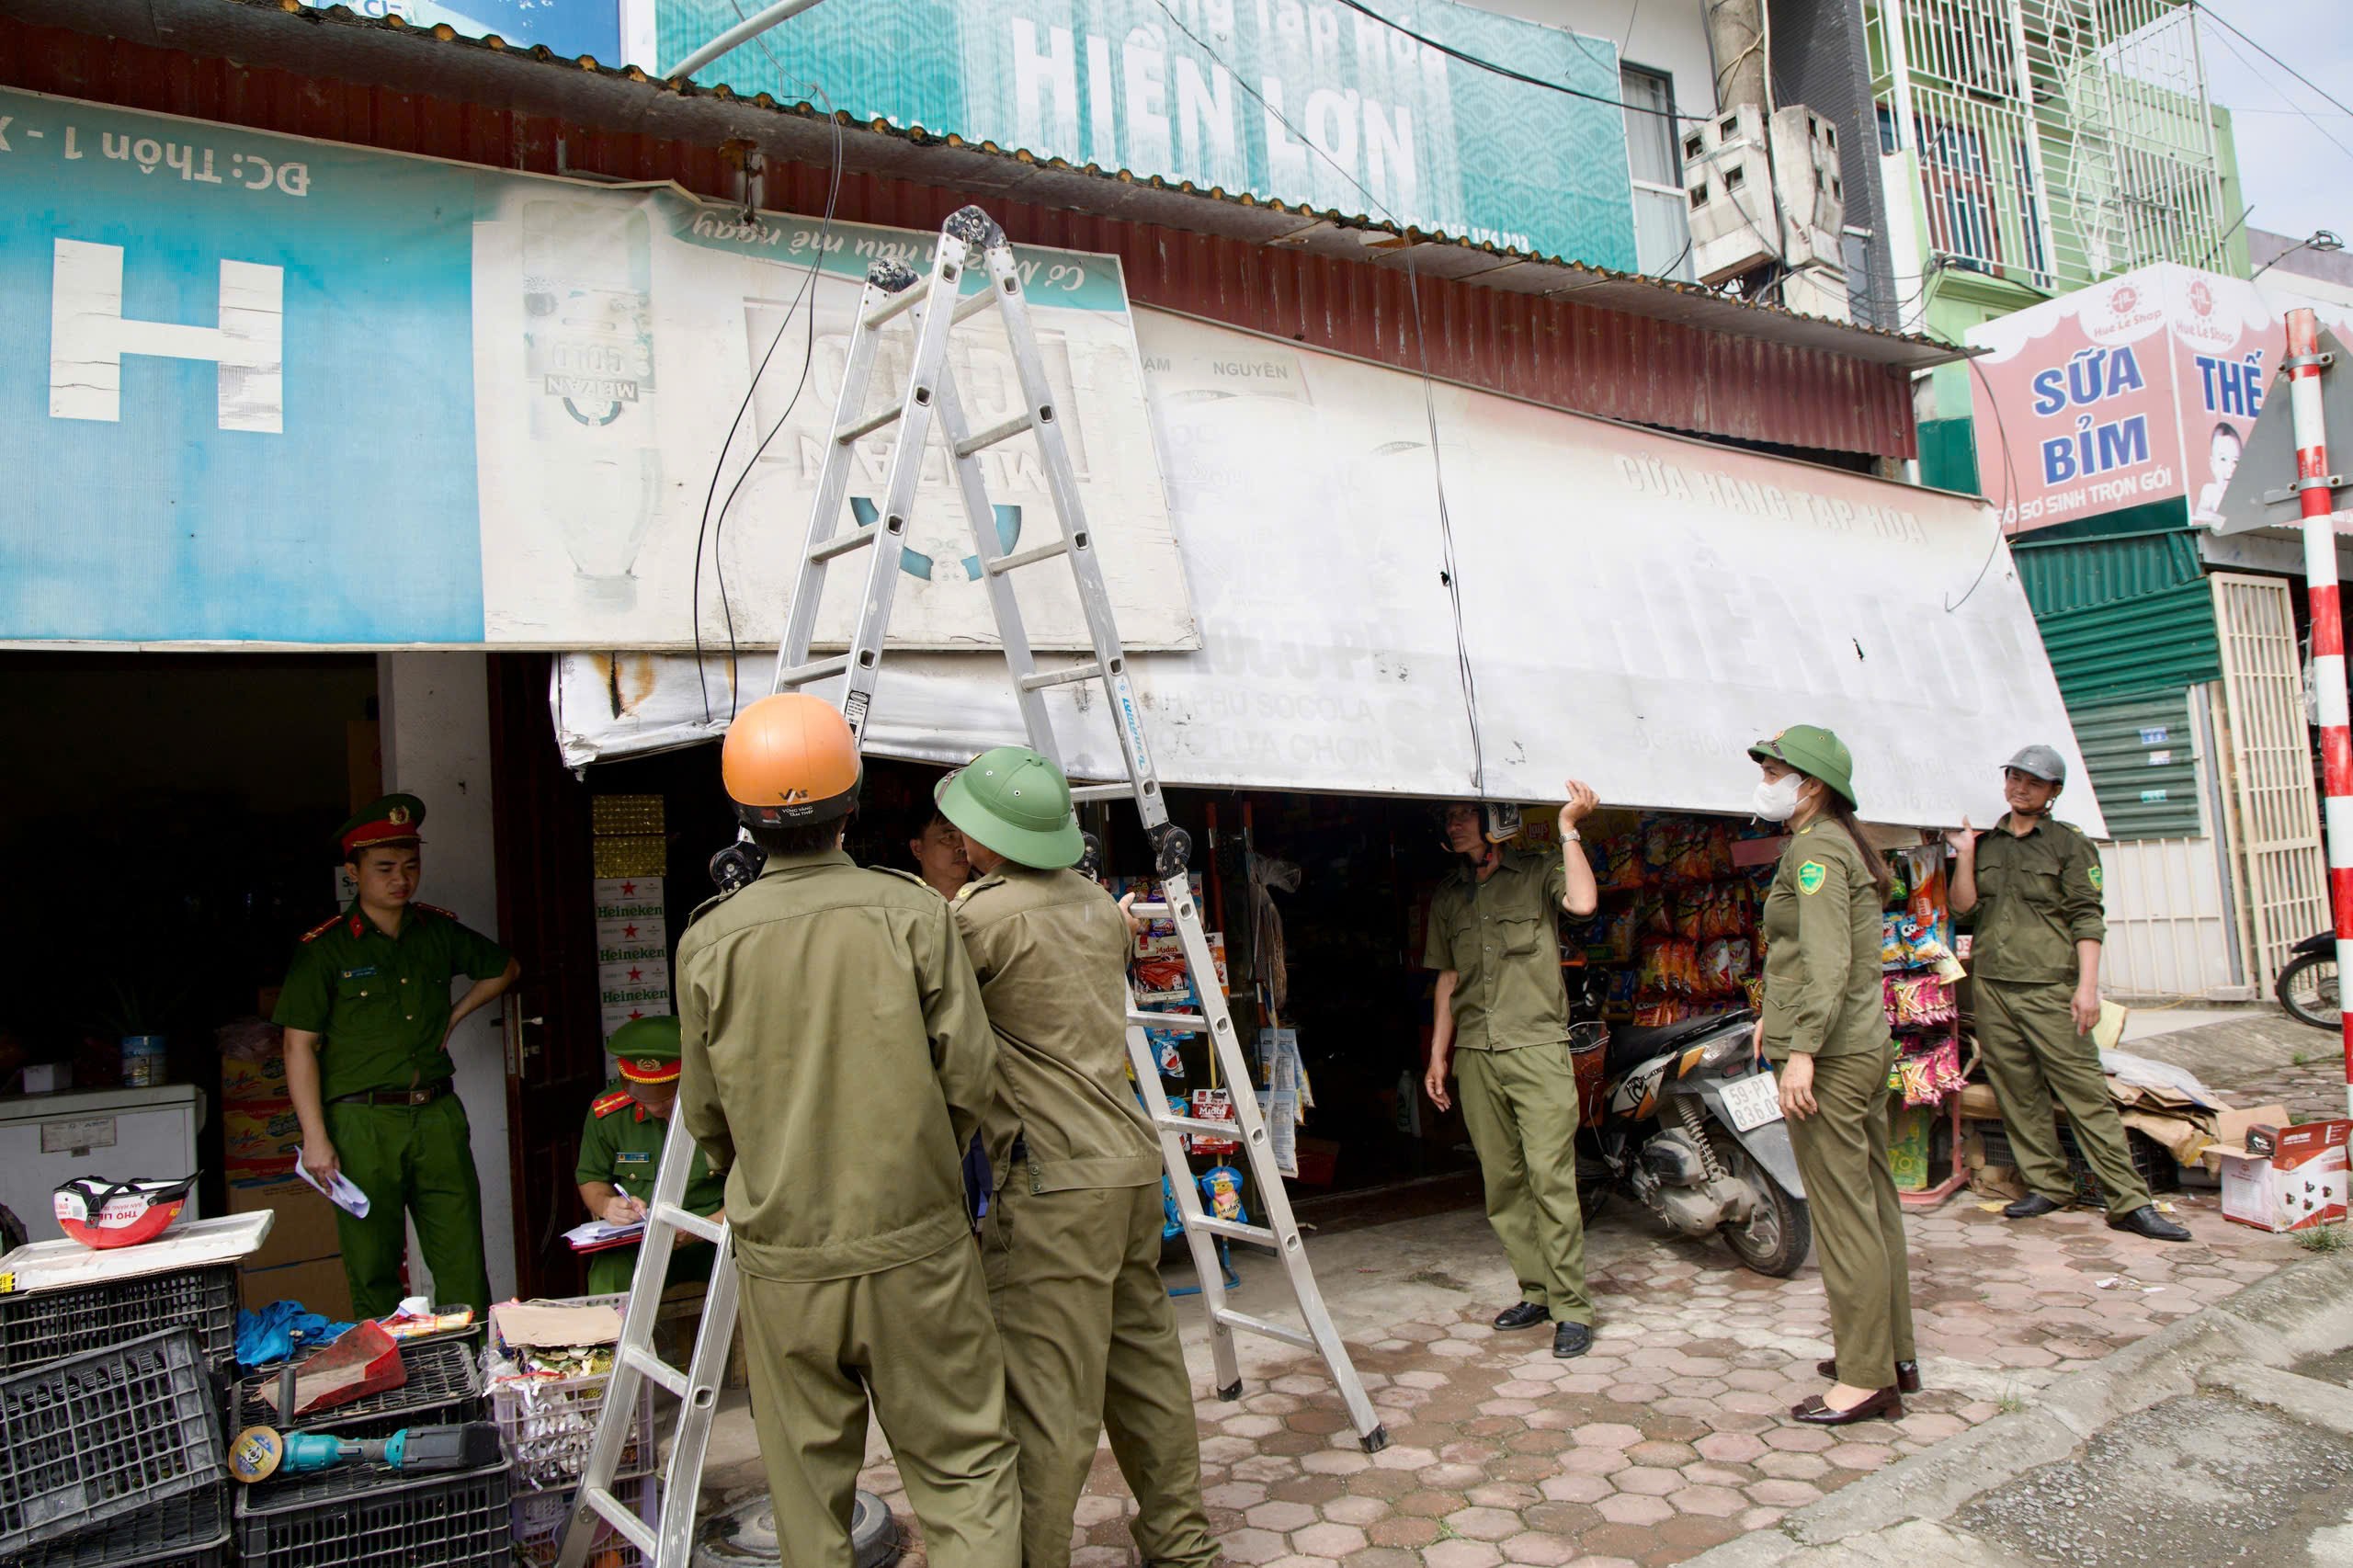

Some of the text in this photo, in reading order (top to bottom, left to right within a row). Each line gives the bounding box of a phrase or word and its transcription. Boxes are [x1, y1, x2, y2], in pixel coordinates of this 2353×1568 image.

[64, 126, 84, 160] 1
[102, 131, 222, 184] Thôn
[233, 153, 312, 197] ĐC:
[50, 237, 284, 434] H
[2133, 309, 2163, 325] Shop
[1212, 359, 1289, 379] NGUYÊN
[2031, 345, 2146, 417] SỮA
[2195, 348, 2264, 420] THẾ
[2040, 413, 2151, 487] BỈM
[2047, 489, 2086, 514] SINH
[2088, 476, 2137, 503] TRỌN
[2141, 465, 2172, 490] GÓI
[597, 904, 663, 918] Heineken
[600, 948, 665, 961] Heineken
[603, 988, 668, 1003] Heineken
